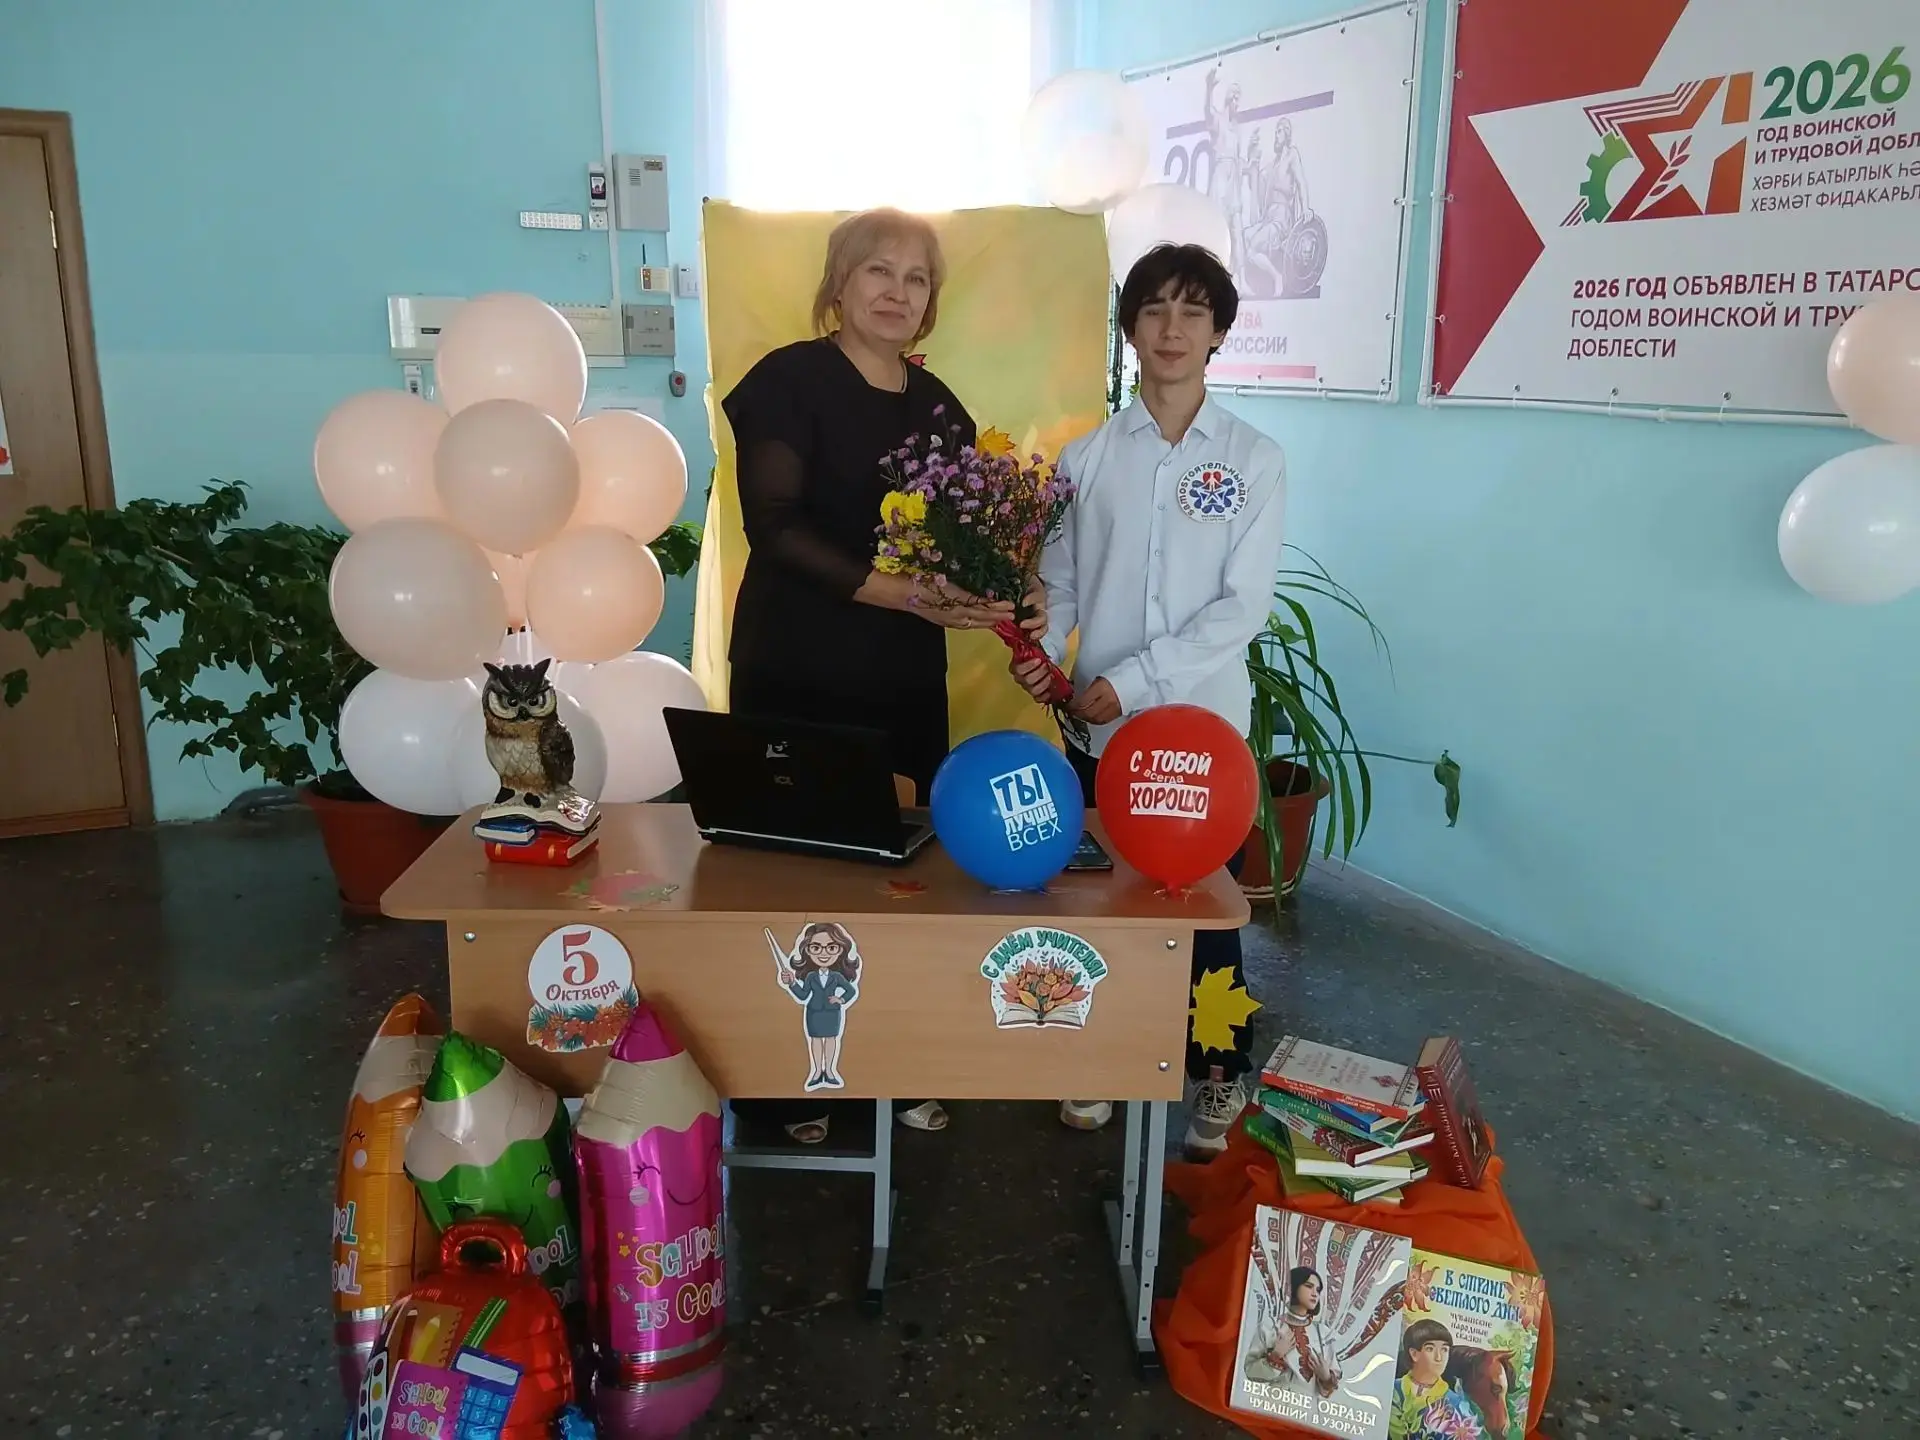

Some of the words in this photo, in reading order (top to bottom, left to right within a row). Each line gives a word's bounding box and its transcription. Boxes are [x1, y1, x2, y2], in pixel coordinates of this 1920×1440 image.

[1760, 46, 1912, 120] 2026
[1757, 125, 1788, 143] ГОД
[1793, 107, 1896, 139] ВОИНСКОЙ
[1755, 151, 1766, 164] И
[1771, 135, 1863, 163] ТРУДОВОЙ
[1866, 132, 1920, 155] ДОБЛ
[1807, 163, 1893, 186] БАТЫРЛЫК
[1816, 184, 1920, 208] ФИДАКАРЬЛ
[1573, 278, 1620, 299] 2026
[1625, 276, 1667, 300] ГОД
[1673, 272, 1795, 296] ОБЪЯВЛЕН
[1803, 271, 1817, 293] В
[1825, 267, 1920, 293] ТАТАРС
[1571, 308, 1641, 330] ГОДОМ
[1648, 301, 1776, 328] ВОИНСКОЙ
[1784, 306, 1800, 327] И
[1567, 337, 1677, 360] ДОБЛЕСТИ
[1130, 750, 1141, 773] С
[1151, 750, 1213, 777] ТОБОЙ
[993, 767, 1045, 813] ТЫ
[1131, 787, 1208, 813] ХОРОШО
[1004, 802, 1058, 837] ЛУЧШЕ
[1008, 820, 1064, 851] ВСЕХ
[562, 930, 599, 986] 5
[982, 964, 1000, 978] С
[1036, 930, 1107, 980] УЧИТЕЛЯ!
[545, 979, 621, 1001] Октября
[1243, 1379, 1313, 1409] ВЕКОВЫЕ
[1317, 1400, 1377, 1427] ОБРАЗЫ
[1249, 1396, 1308, 1422] ЧУВАШИИ
[1322, 1417, 1366, 1437] УЗОРАХ
